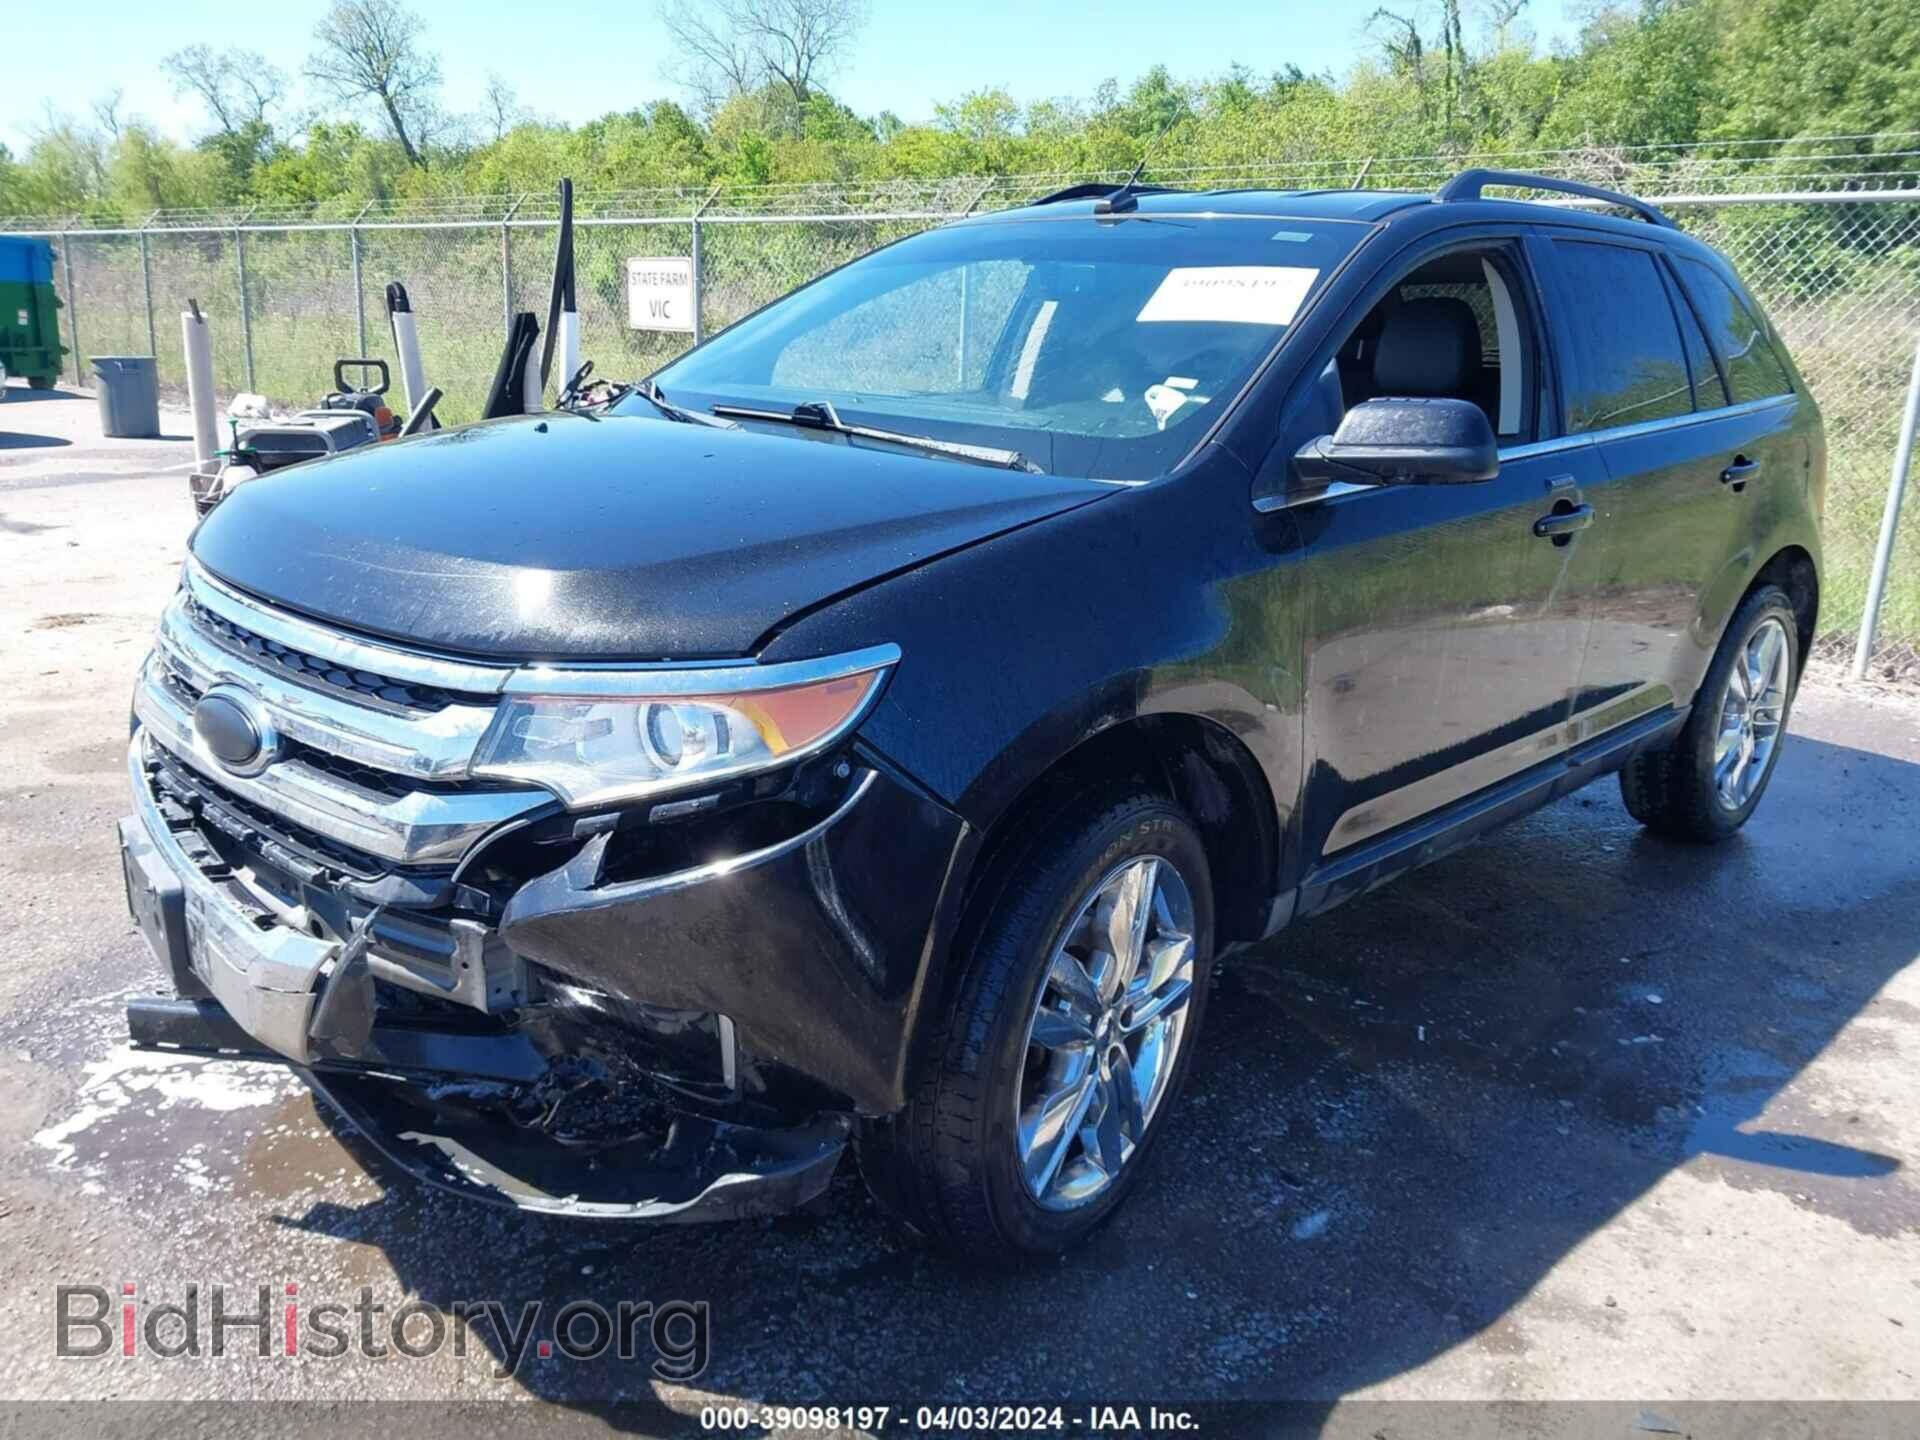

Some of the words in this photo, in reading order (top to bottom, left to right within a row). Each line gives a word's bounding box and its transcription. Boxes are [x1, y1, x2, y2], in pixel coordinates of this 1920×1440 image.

[631, 271, 659, 287] STATE
[660, 271, 688, 287] FARM
[648, 299, 672, 319] VIC
